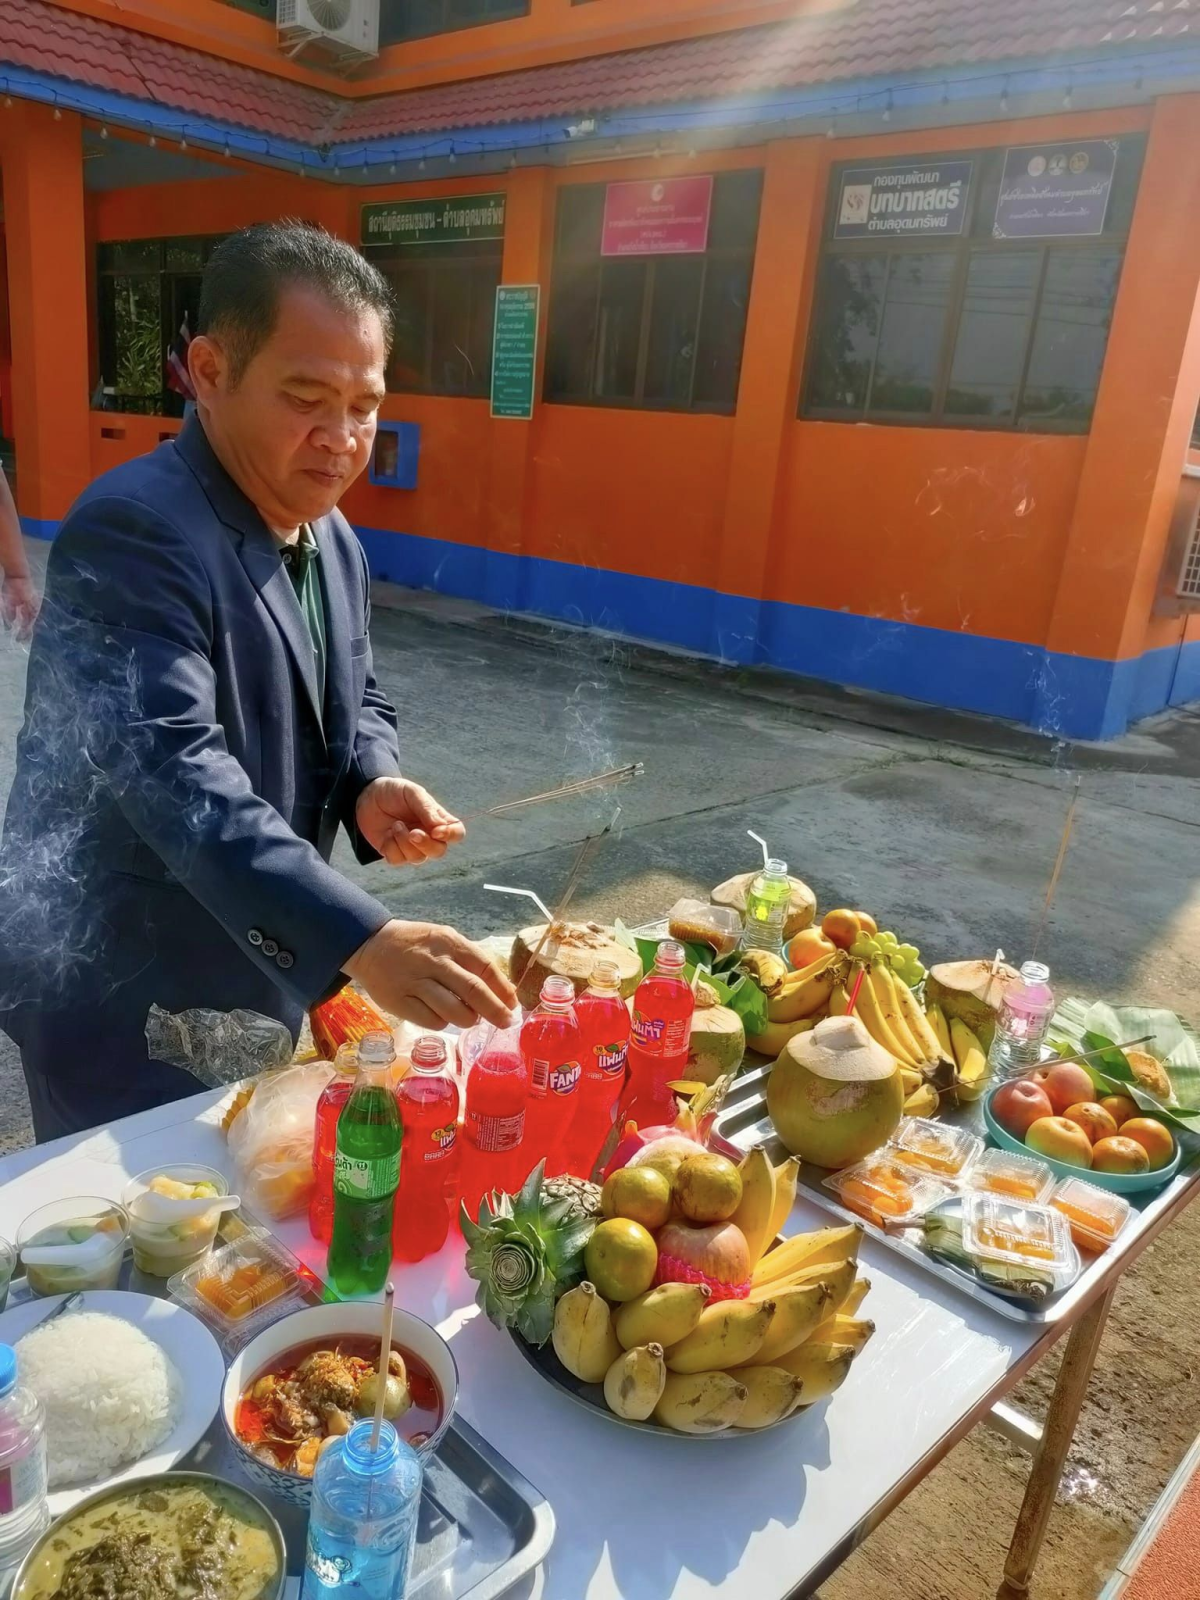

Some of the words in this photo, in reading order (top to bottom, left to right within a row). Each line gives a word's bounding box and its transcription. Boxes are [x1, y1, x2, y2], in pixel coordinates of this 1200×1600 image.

[873, 170, 940, 189] กองทุนพัฒนา
[870, 180, 962, 214] บทบาทสตรี
[868, 213, 949, 233] ตำบลอุดมทรัพย์
[550, 1065, 581, 1089] FANT
